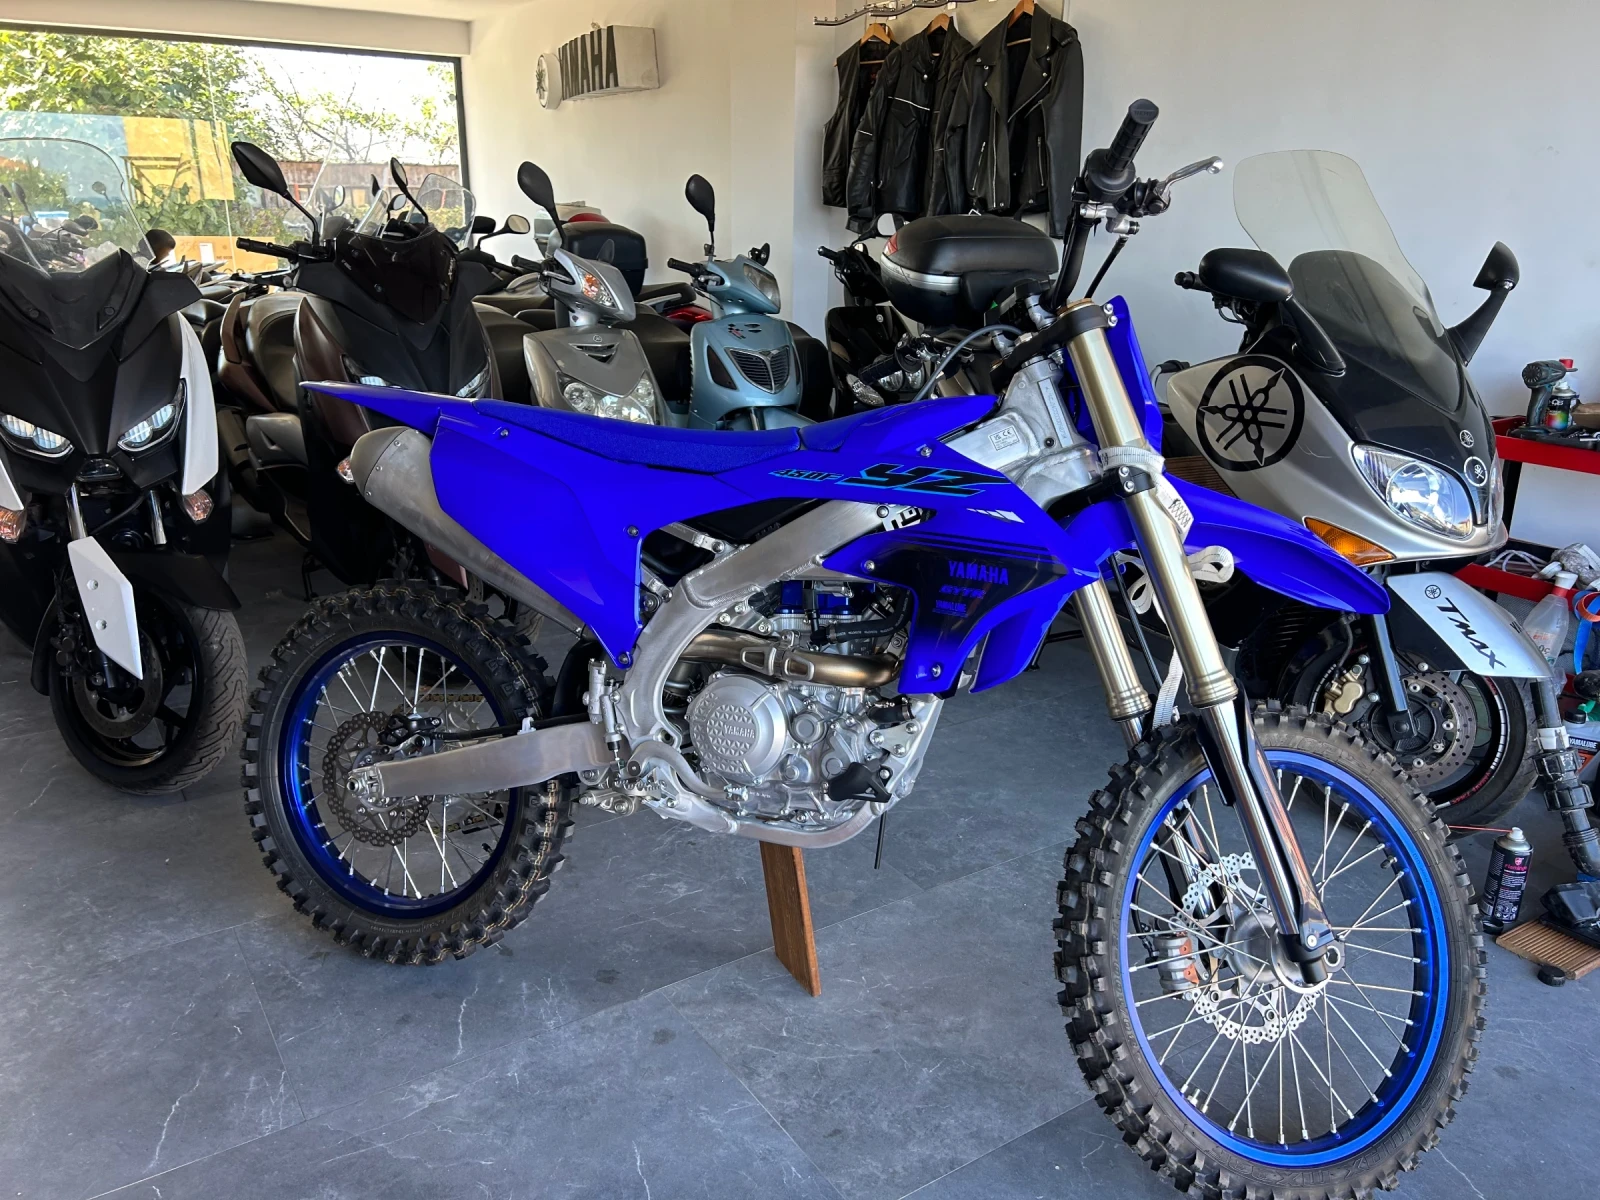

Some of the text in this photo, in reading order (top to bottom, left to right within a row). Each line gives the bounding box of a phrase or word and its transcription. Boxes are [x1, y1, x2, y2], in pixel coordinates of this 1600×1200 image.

[558, 25, 619, 101] YAMAHA
[835, 462, 1011, 497] YZ
[948, 560, 1009, 586] YAMAHA
[1436, 597, 1507, 670] TMAX
[724, 724, 755, 739] YAMAHA
[1569, 737, 1598, 749] YAMALUBE
